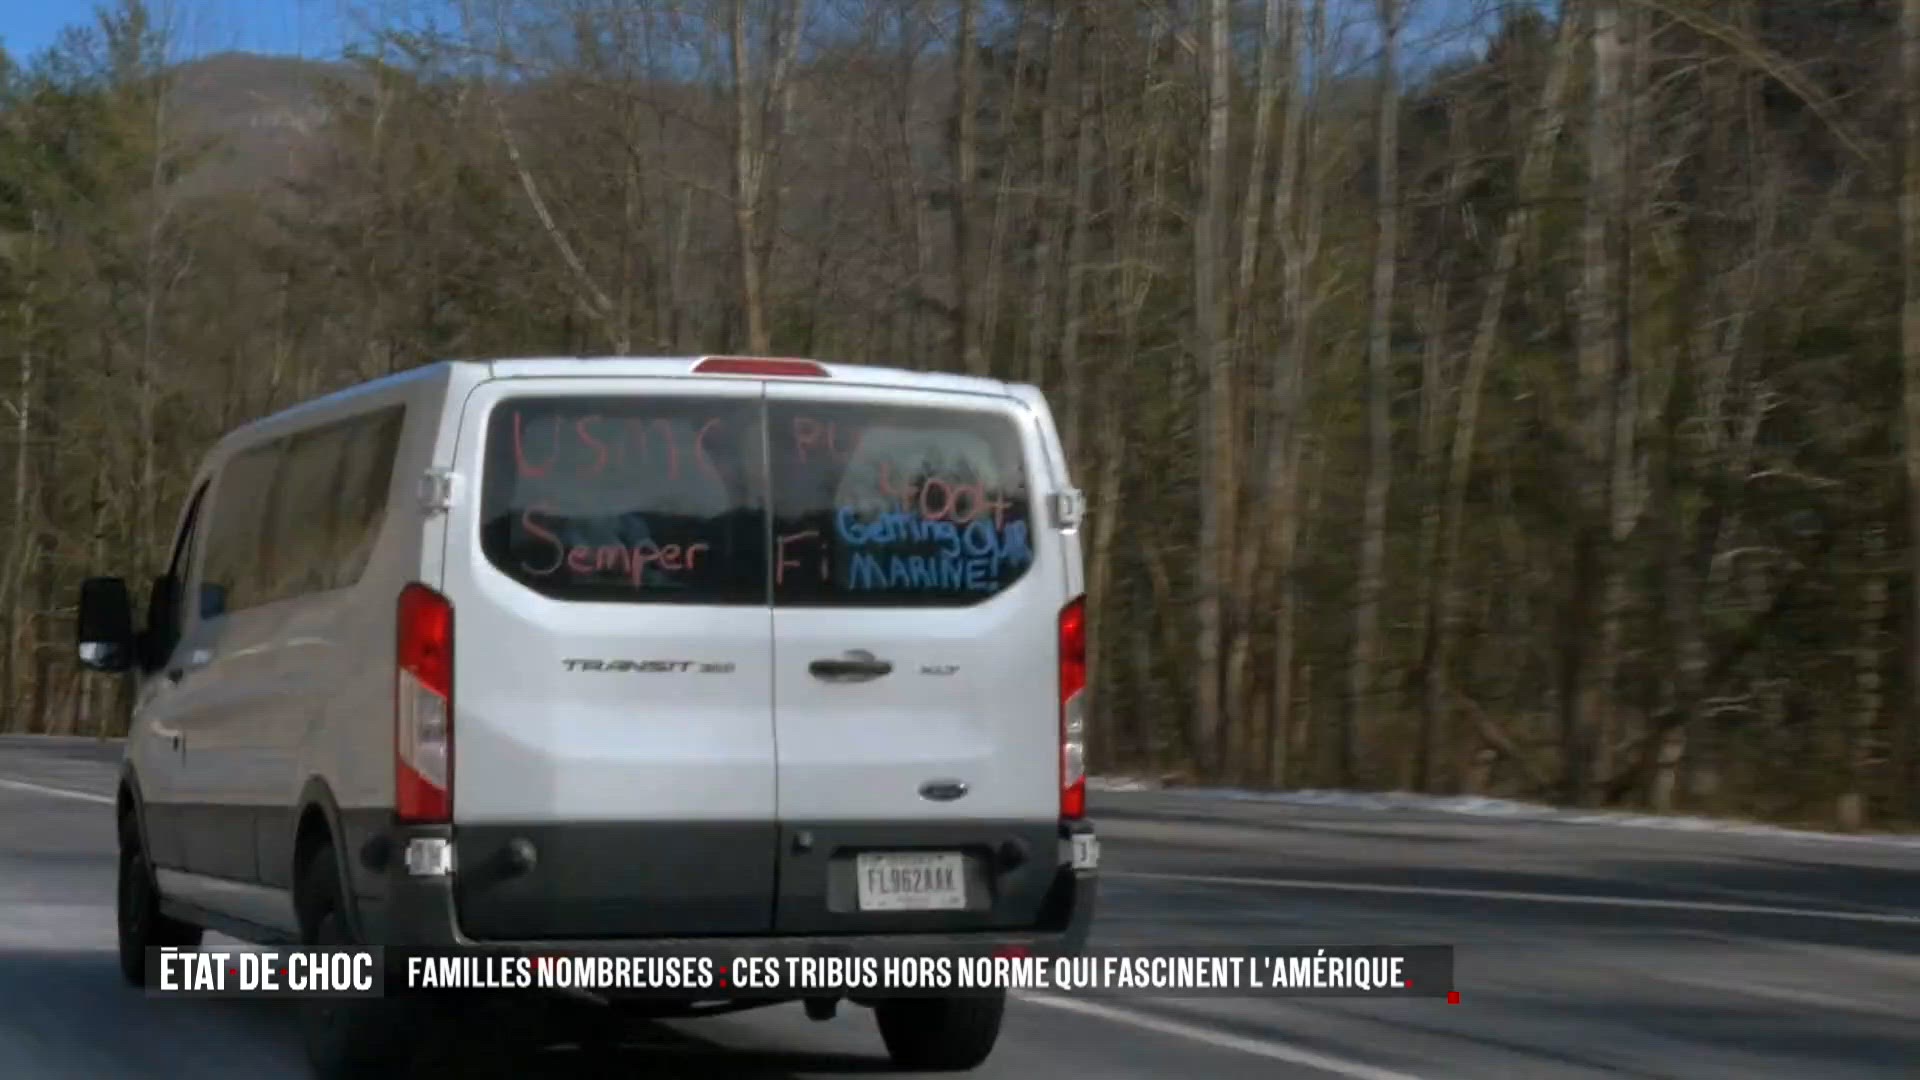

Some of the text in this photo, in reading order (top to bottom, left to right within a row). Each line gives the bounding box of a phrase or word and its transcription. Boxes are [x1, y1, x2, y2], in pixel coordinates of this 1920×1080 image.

[512, 410, 724, 480] USMC
[519, 502, 829, 590] Semper Fi
[836, 505, 960, 556] Getting
[848, 553, 1000, 591] MARINE!
[561, 658, 696, 673] TRANSIT
[867, 863, 956, 895] FL962AAK
